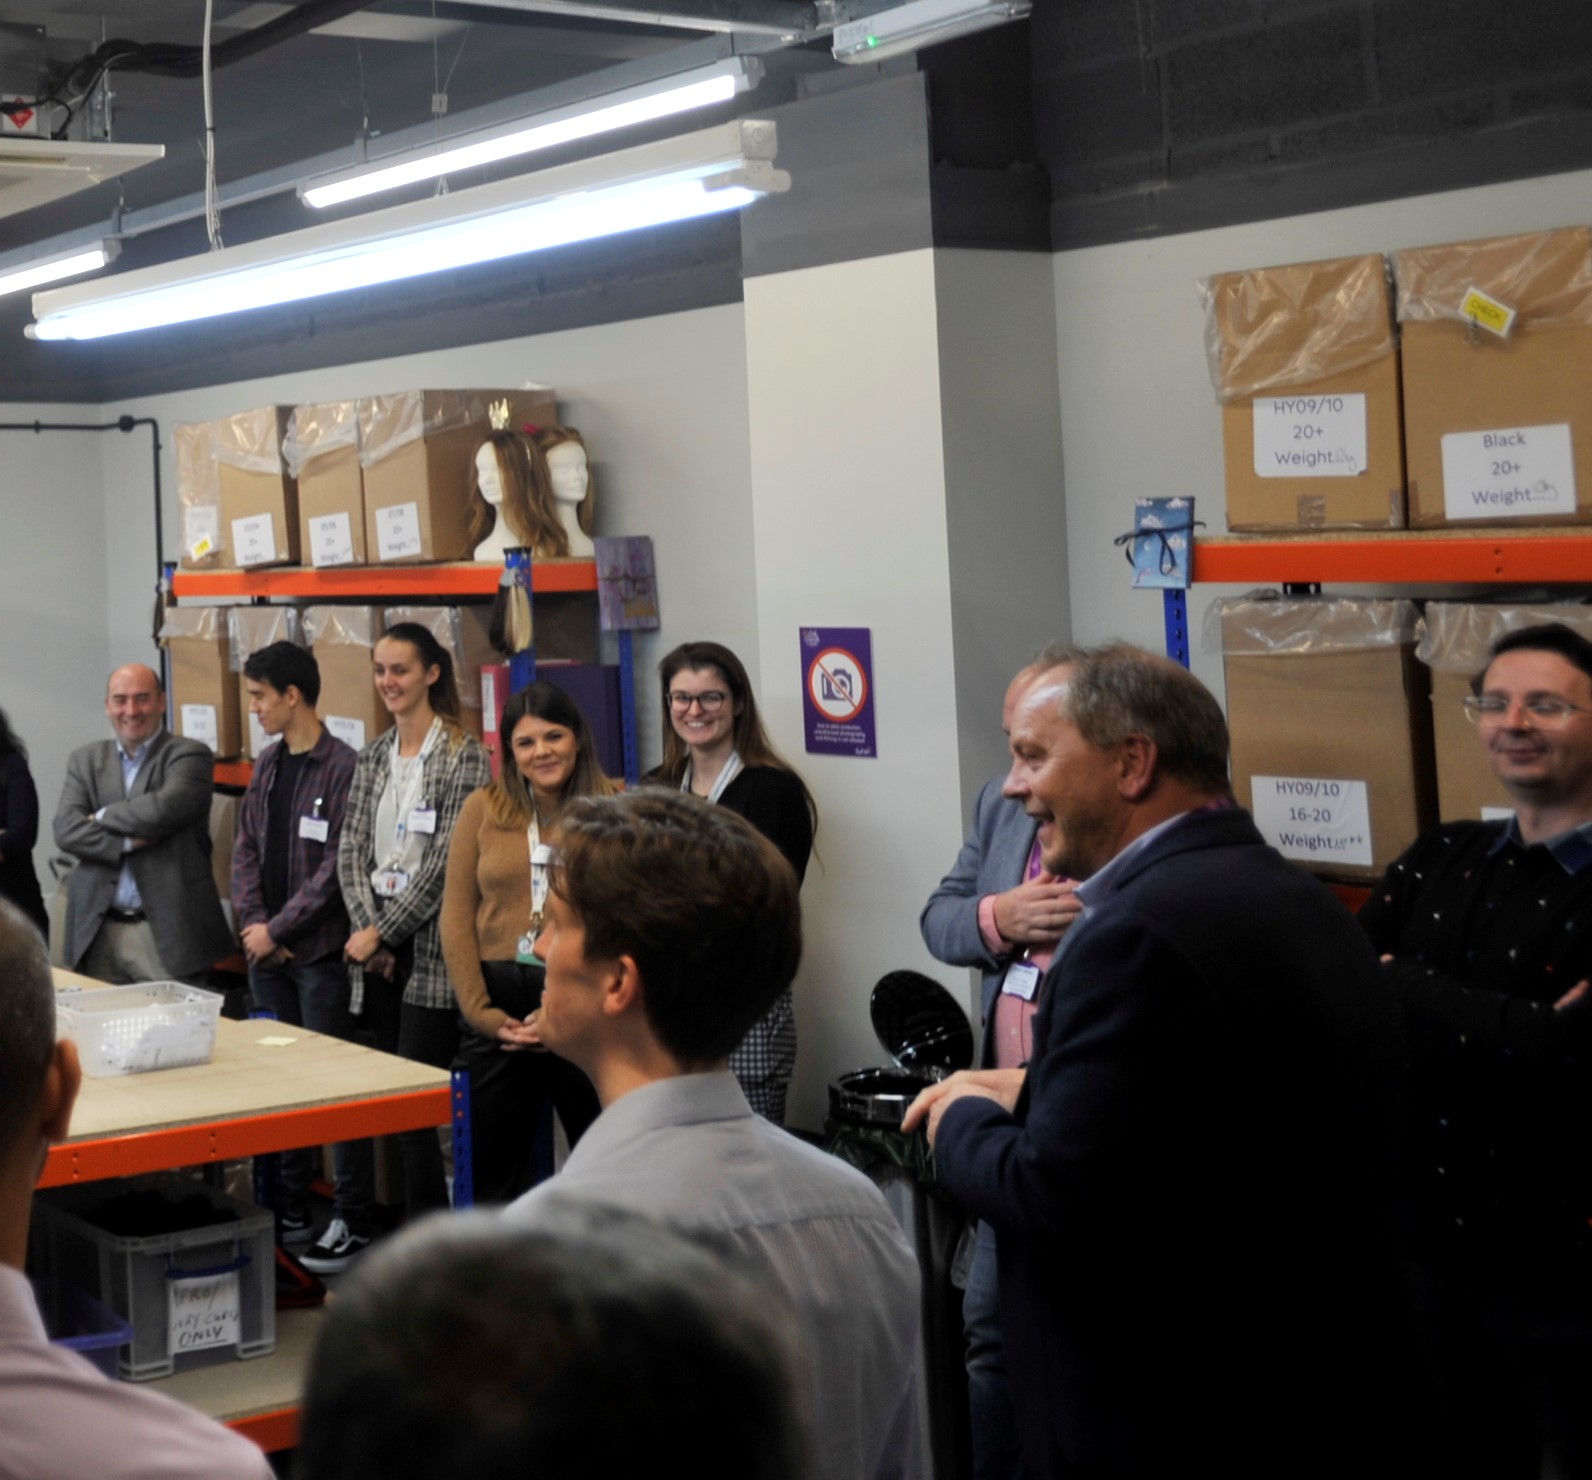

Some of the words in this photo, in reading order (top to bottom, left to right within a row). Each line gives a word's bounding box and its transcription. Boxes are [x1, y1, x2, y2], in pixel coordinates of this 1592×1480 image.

[1273, 396, 1344, 415] HY09/10
[1292, 424, 1324, 440] 20+
[1483, 431, 1526, 449] Black
[1491, 460, 1521, 476] 20+
[1276, 781, 1340, 797] HY09/10
[1289, 807, 1331, 822] 16-20
